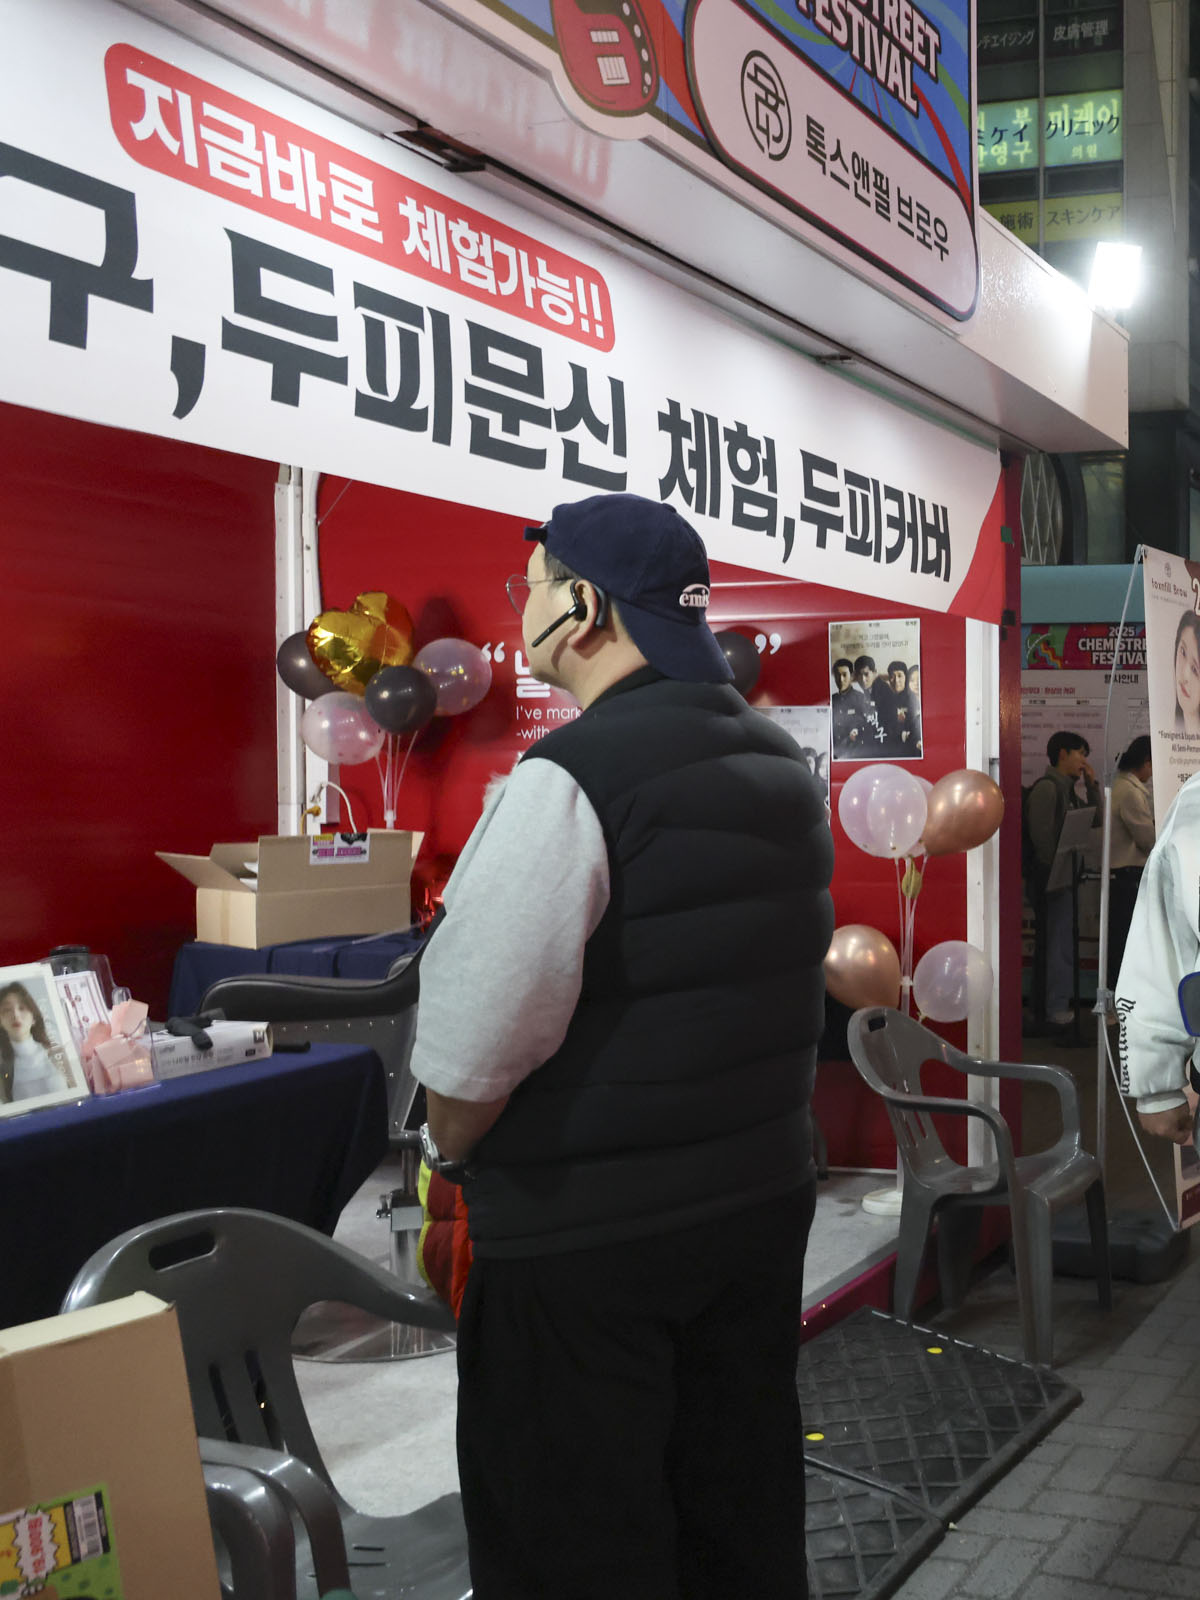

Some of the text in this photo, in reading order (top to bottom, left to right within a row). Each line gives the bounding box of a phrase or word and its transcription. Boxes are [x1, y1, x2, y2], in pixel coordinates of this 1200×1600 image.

[799, 0, 917, 114] ESTIVAL
[852, 0, 940, 79] REET
[1046, 115, 1120, 140] クリニック
[125, 68, 605, 340] 지금바로 체험가능!!
[806, 114, 950, 262] 톡스앤필 브로우
[1047, 206, 1121, 226] スキンケア
[657, 397, 952, 583] 체험,두피커버
[1109, 626, 1135, 637] 2025
[516, 706, 542, 721] I've
